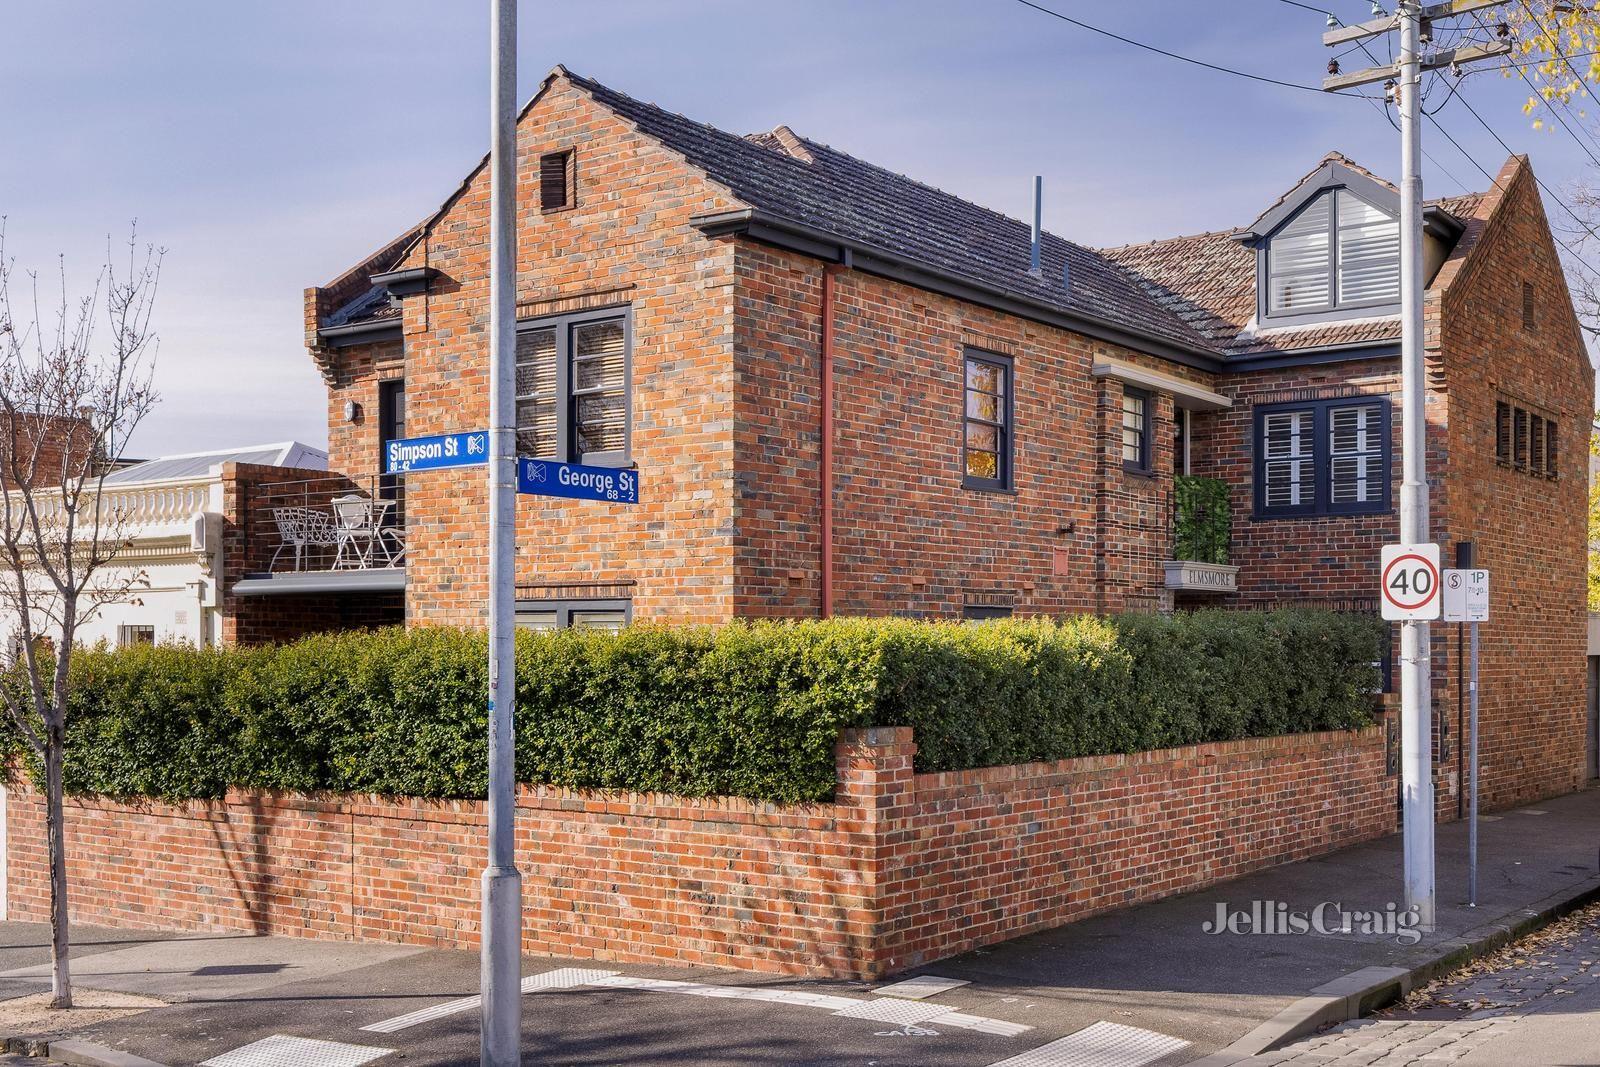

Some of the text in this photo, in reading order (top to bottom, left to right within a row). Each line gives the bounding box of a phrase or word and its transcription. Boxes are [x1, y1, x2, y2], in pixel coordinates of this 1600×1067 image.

[390, 438, 458, 465] Simpson St
[559, 466, 634, 493] George St
[607, 490, 618, 500] 68
[628, 492, 634, 501] 2
[1189, 570, 1230, 586] ELMSMORE
[1390, 568, 1431, 595] 40
[1471, 571, 1485, 583] 1P
